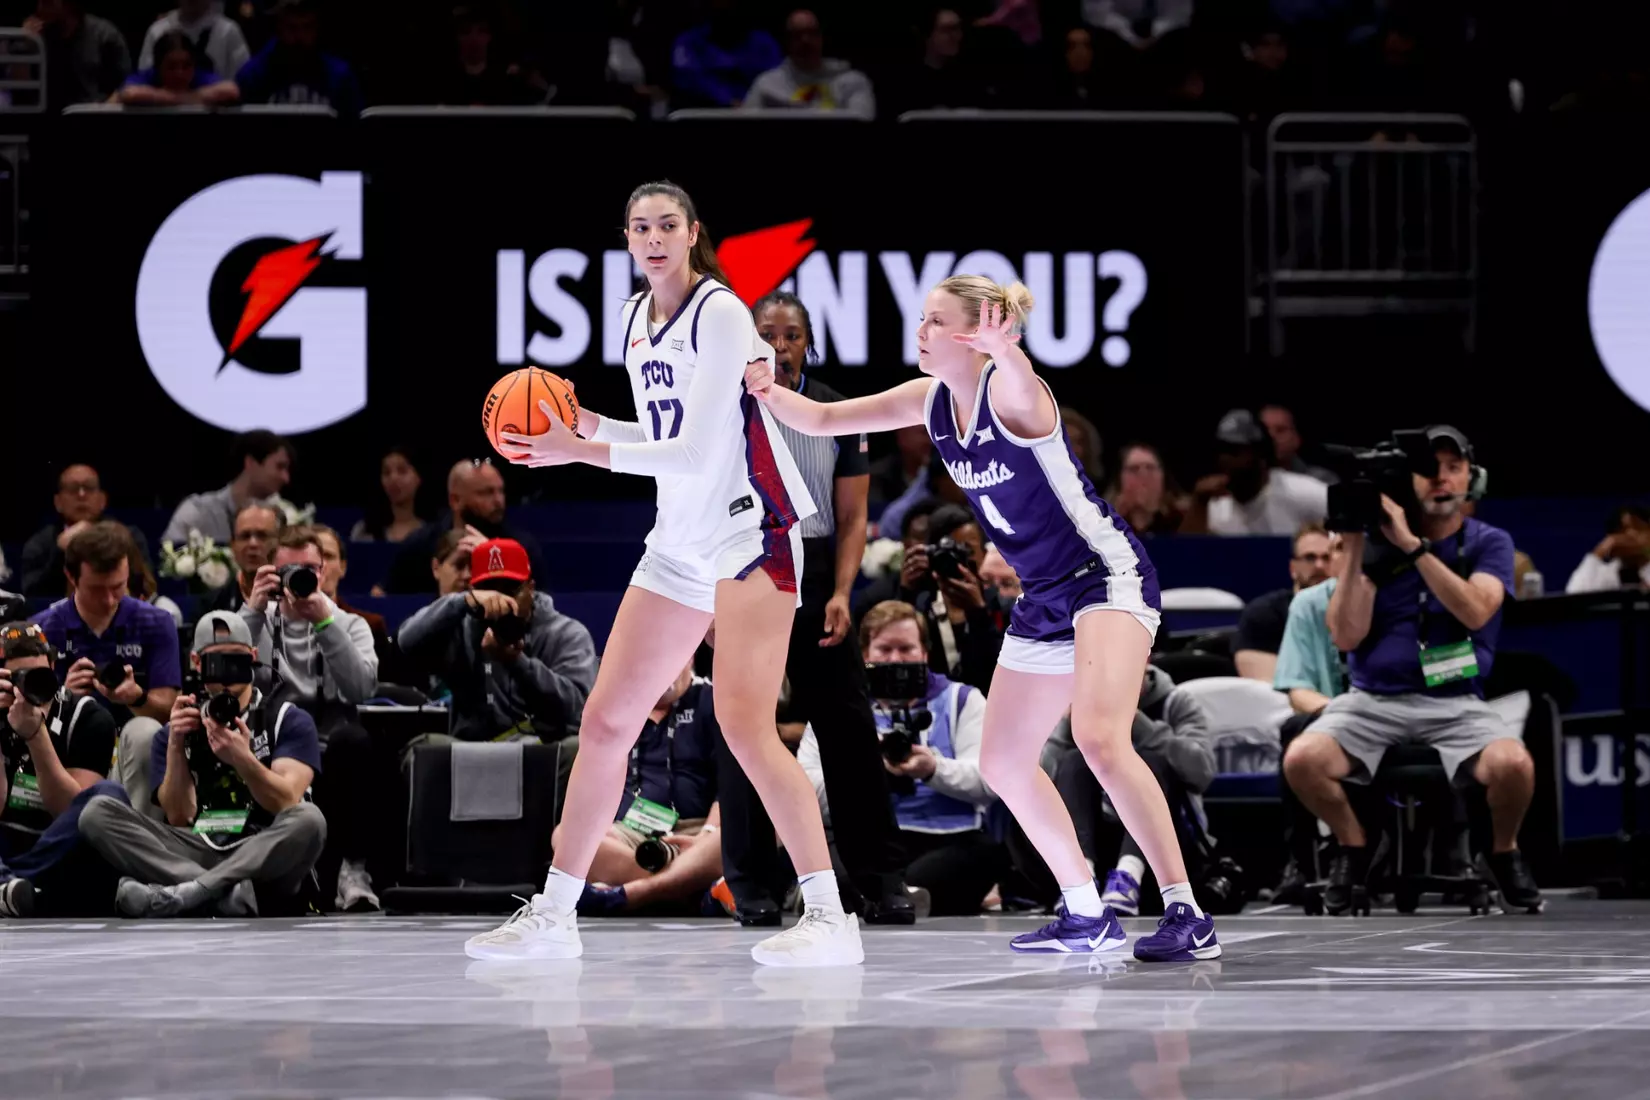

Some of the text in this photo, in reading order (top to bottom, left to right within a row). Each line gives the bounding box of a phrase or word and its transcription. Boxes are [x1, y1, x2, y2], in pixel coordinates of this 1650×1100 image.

[136, 171, 367, 435] G
[497, 248, 591, 366] IS
[768, 250, 868, 365] N
[641, 360, 675, 390] TCU
[564, 392, 579, 435] ilson
[647, 398, 684, 441] 17
[942, 458, 1015, 489] Wildcats
[979, 494, 1016, 535] 4
